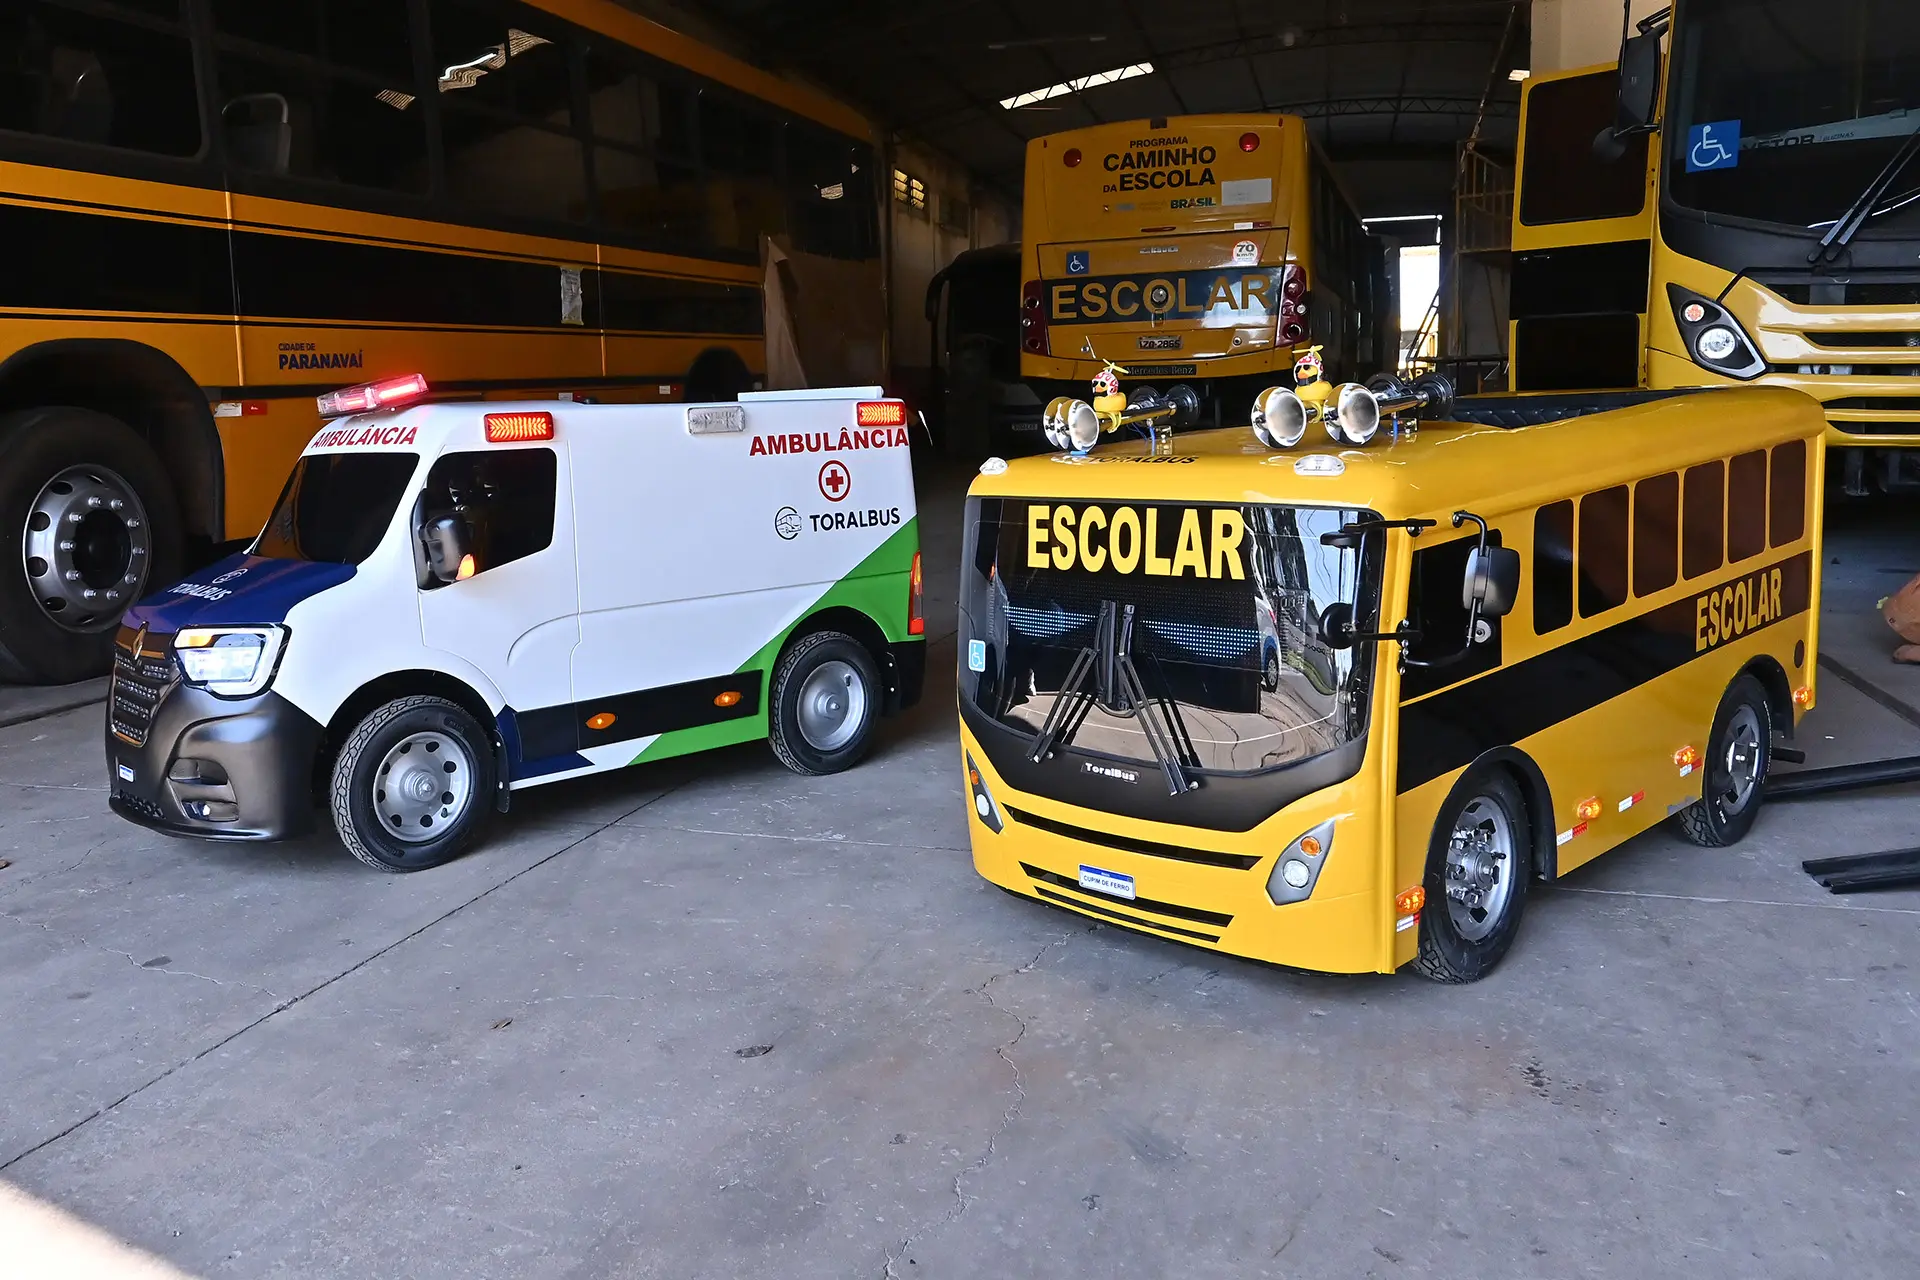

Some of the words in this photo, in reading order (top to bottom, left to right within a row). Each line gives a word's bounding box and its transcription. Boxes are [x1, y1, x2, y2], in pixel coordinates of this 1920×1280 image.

[1129, 136, 1188, 149] PROGRAMA
[1103, 146, 1217, 172] CAMINHO
[1103, 184, 1117, 193] DA
[1119, 168, 1216, 192] ESCOLA
[1170, 197, 1216, 209] BRASIL
[1236, 244, 1255, 253] 70
[1051, 274, 1272, 319] ESCOLAR
[278, 343, 305, 351] CIDADE
[306, 343, 315, 351] DE
[279, 349, 363, 370] PARANAVAÍ
[1171, 365, 1194, 374] Benz
[311, 424, 419, 449] AMBULÂNCIA
[749, 427, 909, 456] AMBULÂNCIA
[1088, 455, 1200, 464] TORALBUS
[809, 507, 901, 532] TORALBUS
[1027, 504, 1246, 581] ESCOLAR
[167, 583, 233, 601] TORALBUS
[1695, 567, 1782, 652] ESCOLAR
[1085, 762, 1136, 781] ToralBus
[1101, 879, 1109, 887] DE
[1110, 882, 1130, 892] FERRO
